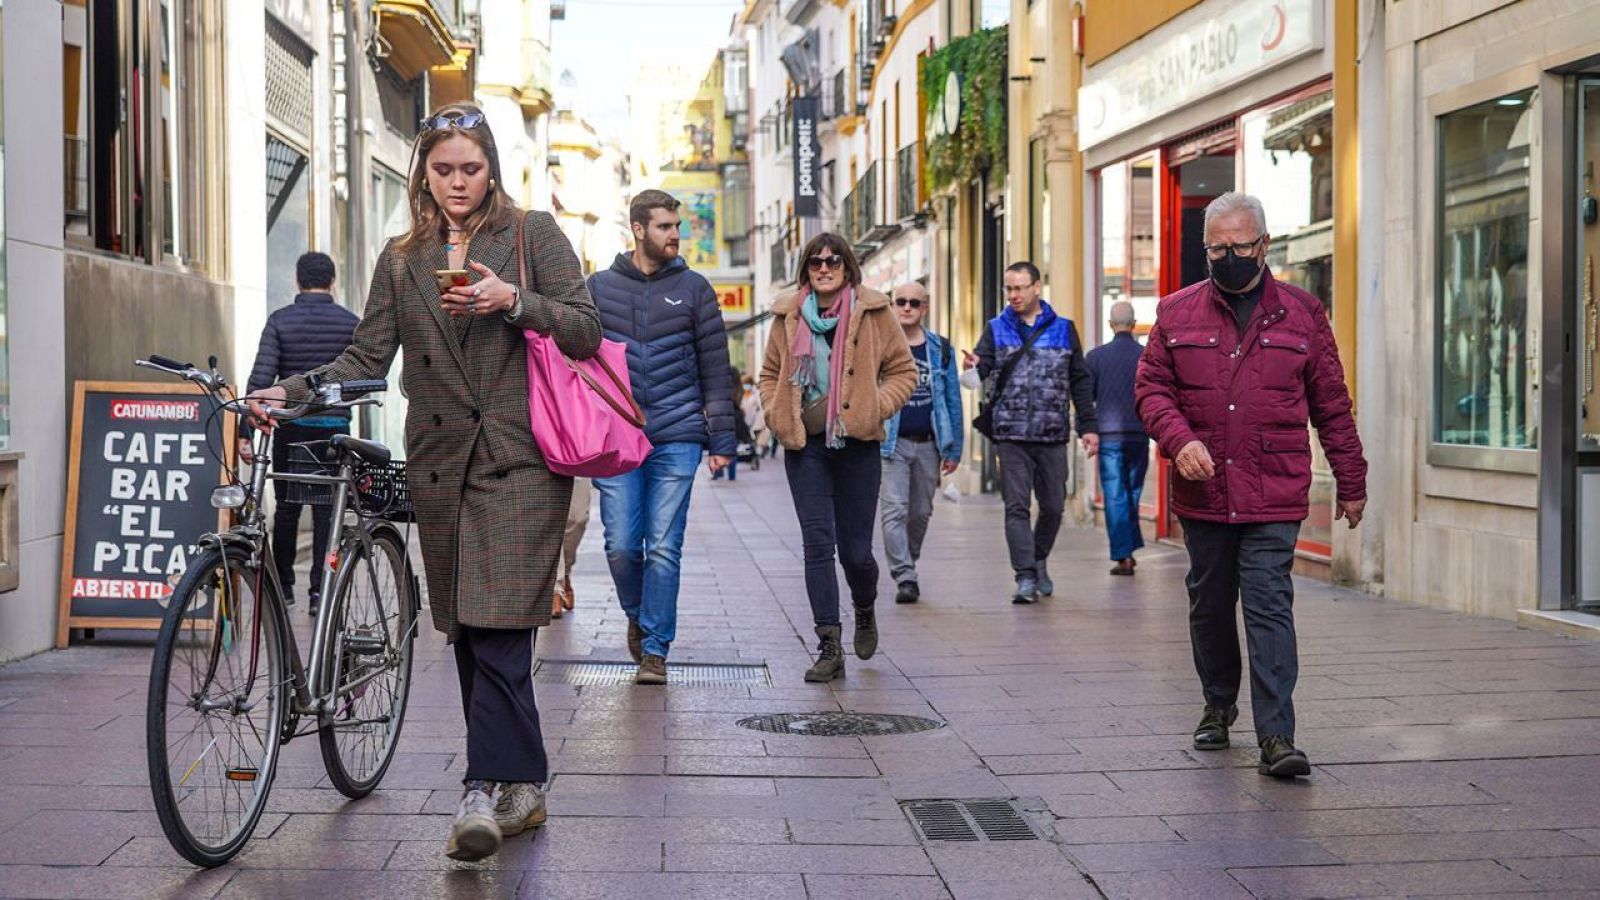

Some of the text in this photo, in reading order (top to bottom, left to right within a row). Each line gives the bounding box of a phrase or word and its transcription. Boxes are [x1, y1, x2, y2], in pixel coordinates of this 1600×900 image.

[1190, 23, 1238, 81] PABLO
[103, 431, 206, 465] CAFE
[110, 468, 190, 502] BAR
[103, 504, 175, 539] “EL
[93, 541, 204, 576] PICA”
[73, 579, 164, 600] ABIERTO
